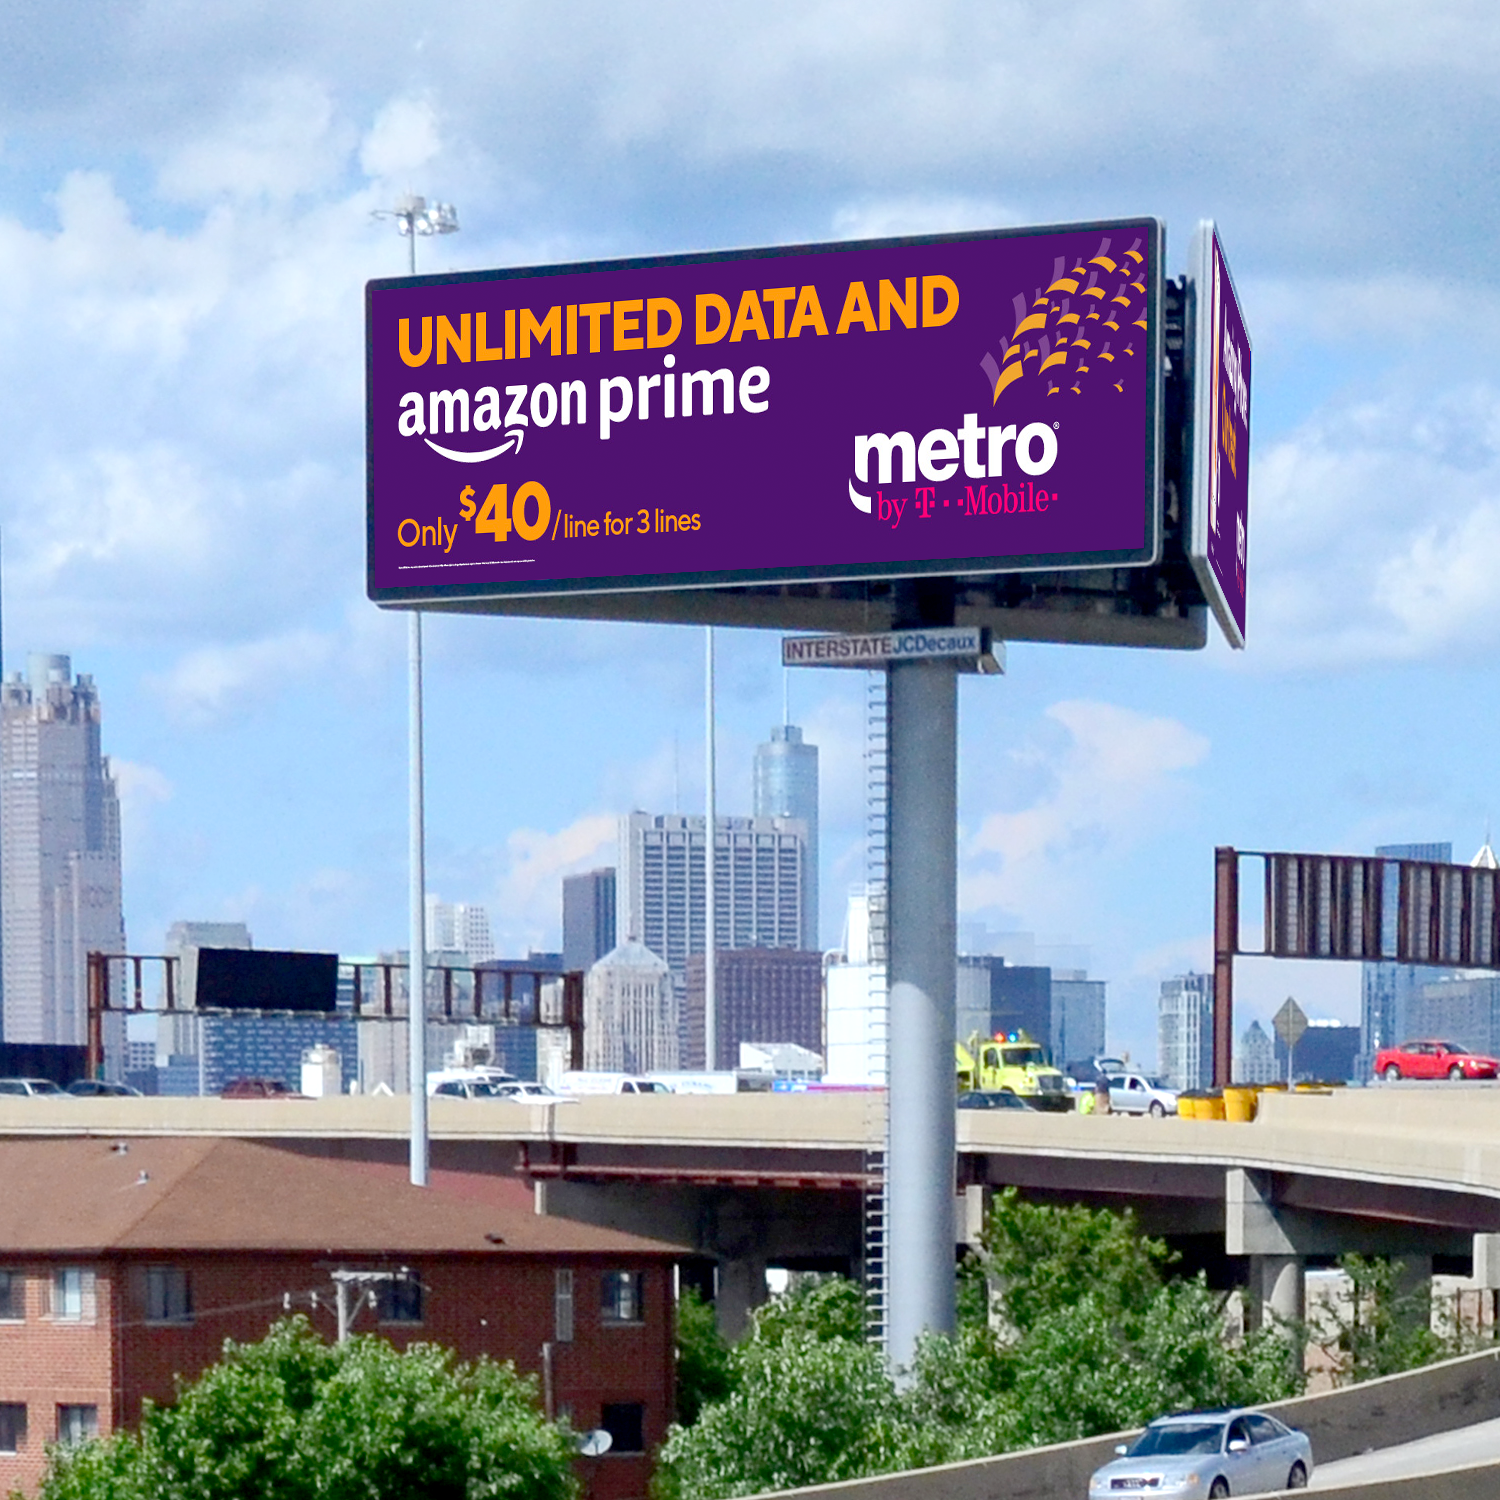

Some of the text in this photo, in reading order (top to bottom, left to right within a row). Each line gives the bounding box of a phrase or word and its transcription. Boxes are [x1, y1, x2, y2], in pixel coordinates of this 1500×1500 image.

[398, 274, 960, 368] UNLIMITED DATA AND
[398, 353, 770, 440] amazon prime
[397, 516, 459, 554] Only
[603, 510, 634, 537] for
[636, 508, 650, 534] 3
[655, 507, 702, 533] lines
[876, 490, 909, 530] by
